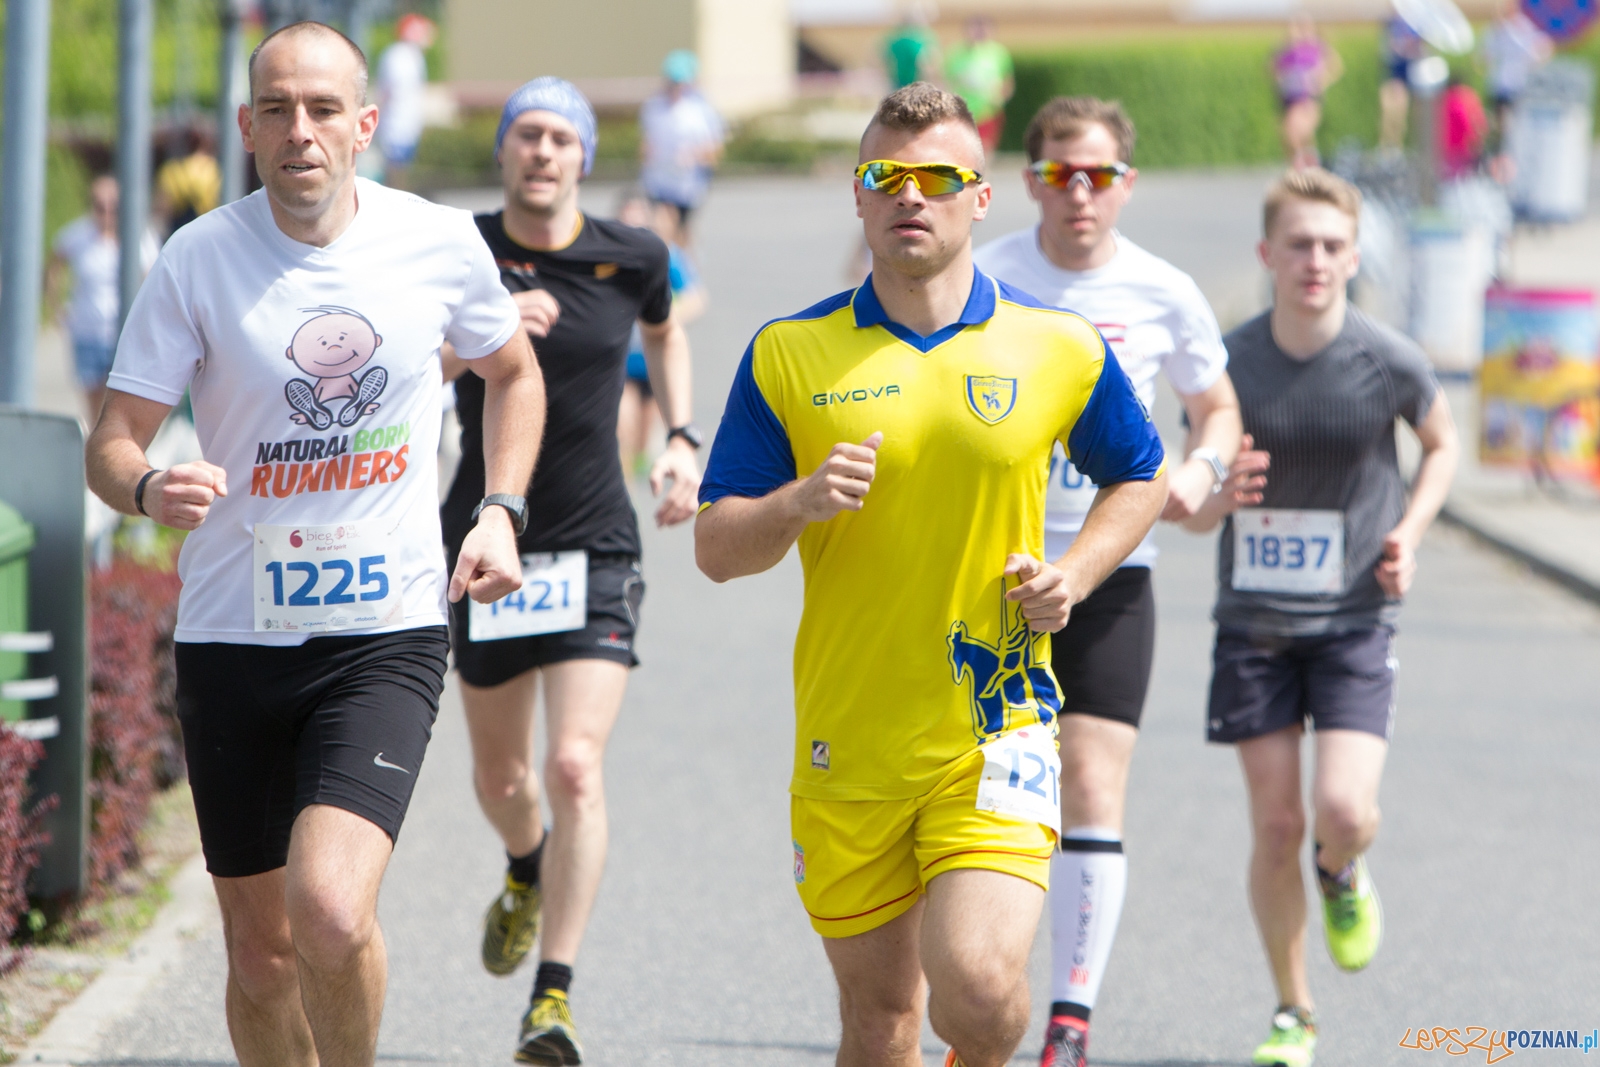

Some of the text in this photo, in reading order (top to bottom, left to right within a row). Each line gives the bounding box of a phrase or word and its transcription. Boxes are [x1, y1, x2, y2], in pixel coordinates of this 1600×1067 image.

[812, 384, 901, 406] GIVOVA
[255, 421, 411, 464] NATURAL BORN
[250, 444, 410, 499] RUNNERS
[306, 529, 334, 545] bieg
[1246, 535, 1330, 569] 1837
[265, 555, 389, 606] 1225
